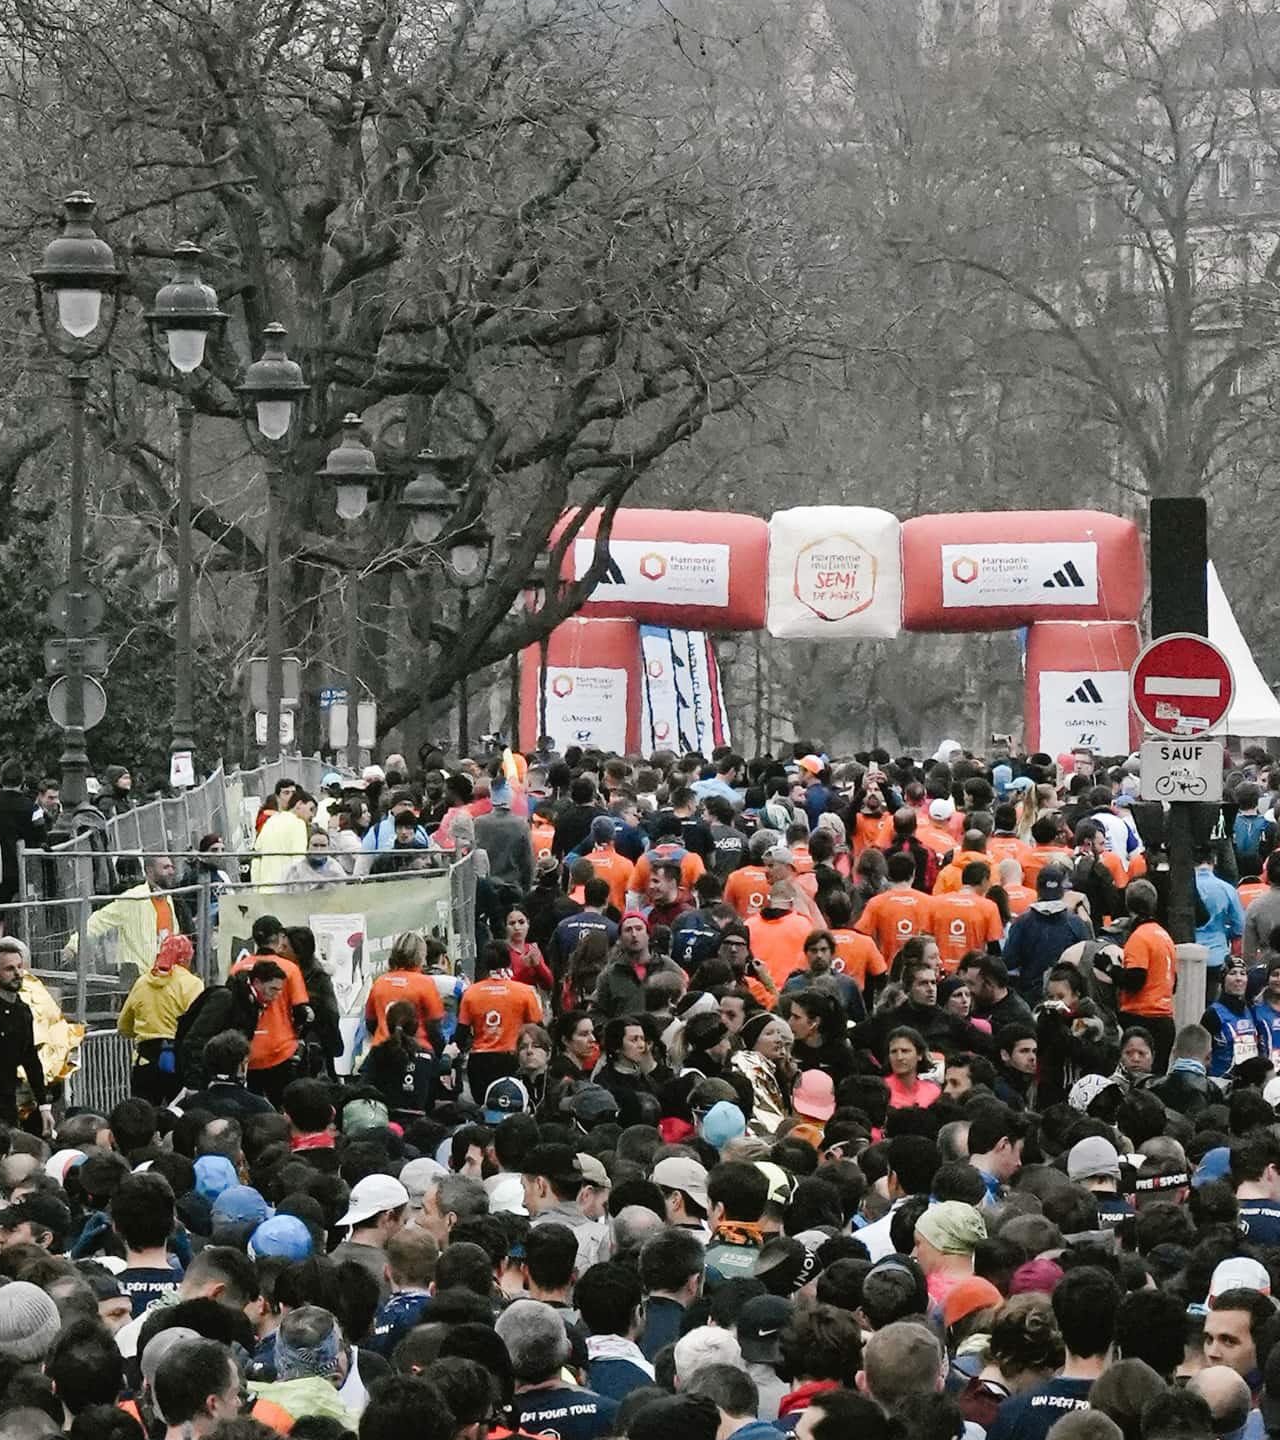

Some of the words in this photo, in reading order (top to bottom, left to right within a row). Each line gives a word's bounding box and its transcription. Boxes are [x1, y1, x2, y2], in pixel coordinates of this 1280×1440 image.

[1160, 746, 1203, 761] SAUF
[126, 1281, 147, 1292] DÉFI
[148, 1281, 174, 1293] POUR
[1031, 1395, 1048, 1406] UN
[1075, 1399, 1090, 1410] PO
[539, 1407, 567, 1420] POUR
[570, 1403, 597, 1415] TOUS
